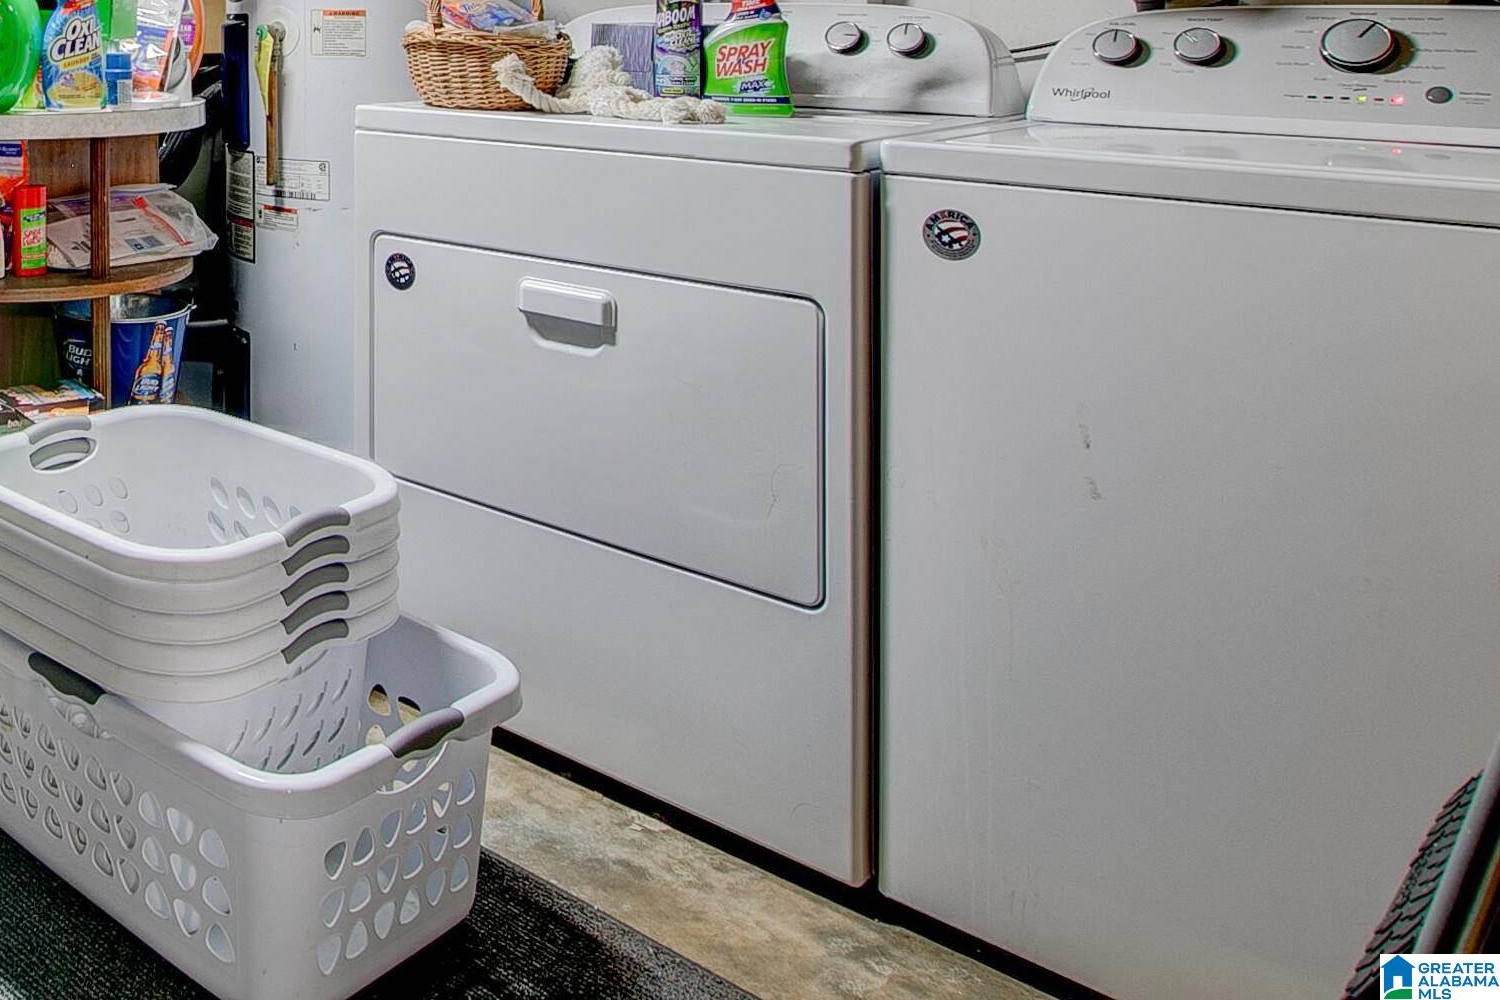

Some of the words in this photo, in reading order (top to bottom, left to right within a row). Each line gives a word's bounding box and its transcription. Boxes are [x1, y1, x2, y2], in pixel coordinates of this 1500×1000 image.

[66, 17, 95, 39] OXI
[50, 32, 101, 62] CLEAN
[717, 41, 773, 62] SPRAY
[716, 58, 767, 78] WASH
[740, 79, 769, 93] MAX
[1051, 87, 1111, 101] Whirlpool
[926, 209, 976, 230] AMERICA
[65, 351, 91, 366] LIGH
[68, 344, 92, 357] BUD
